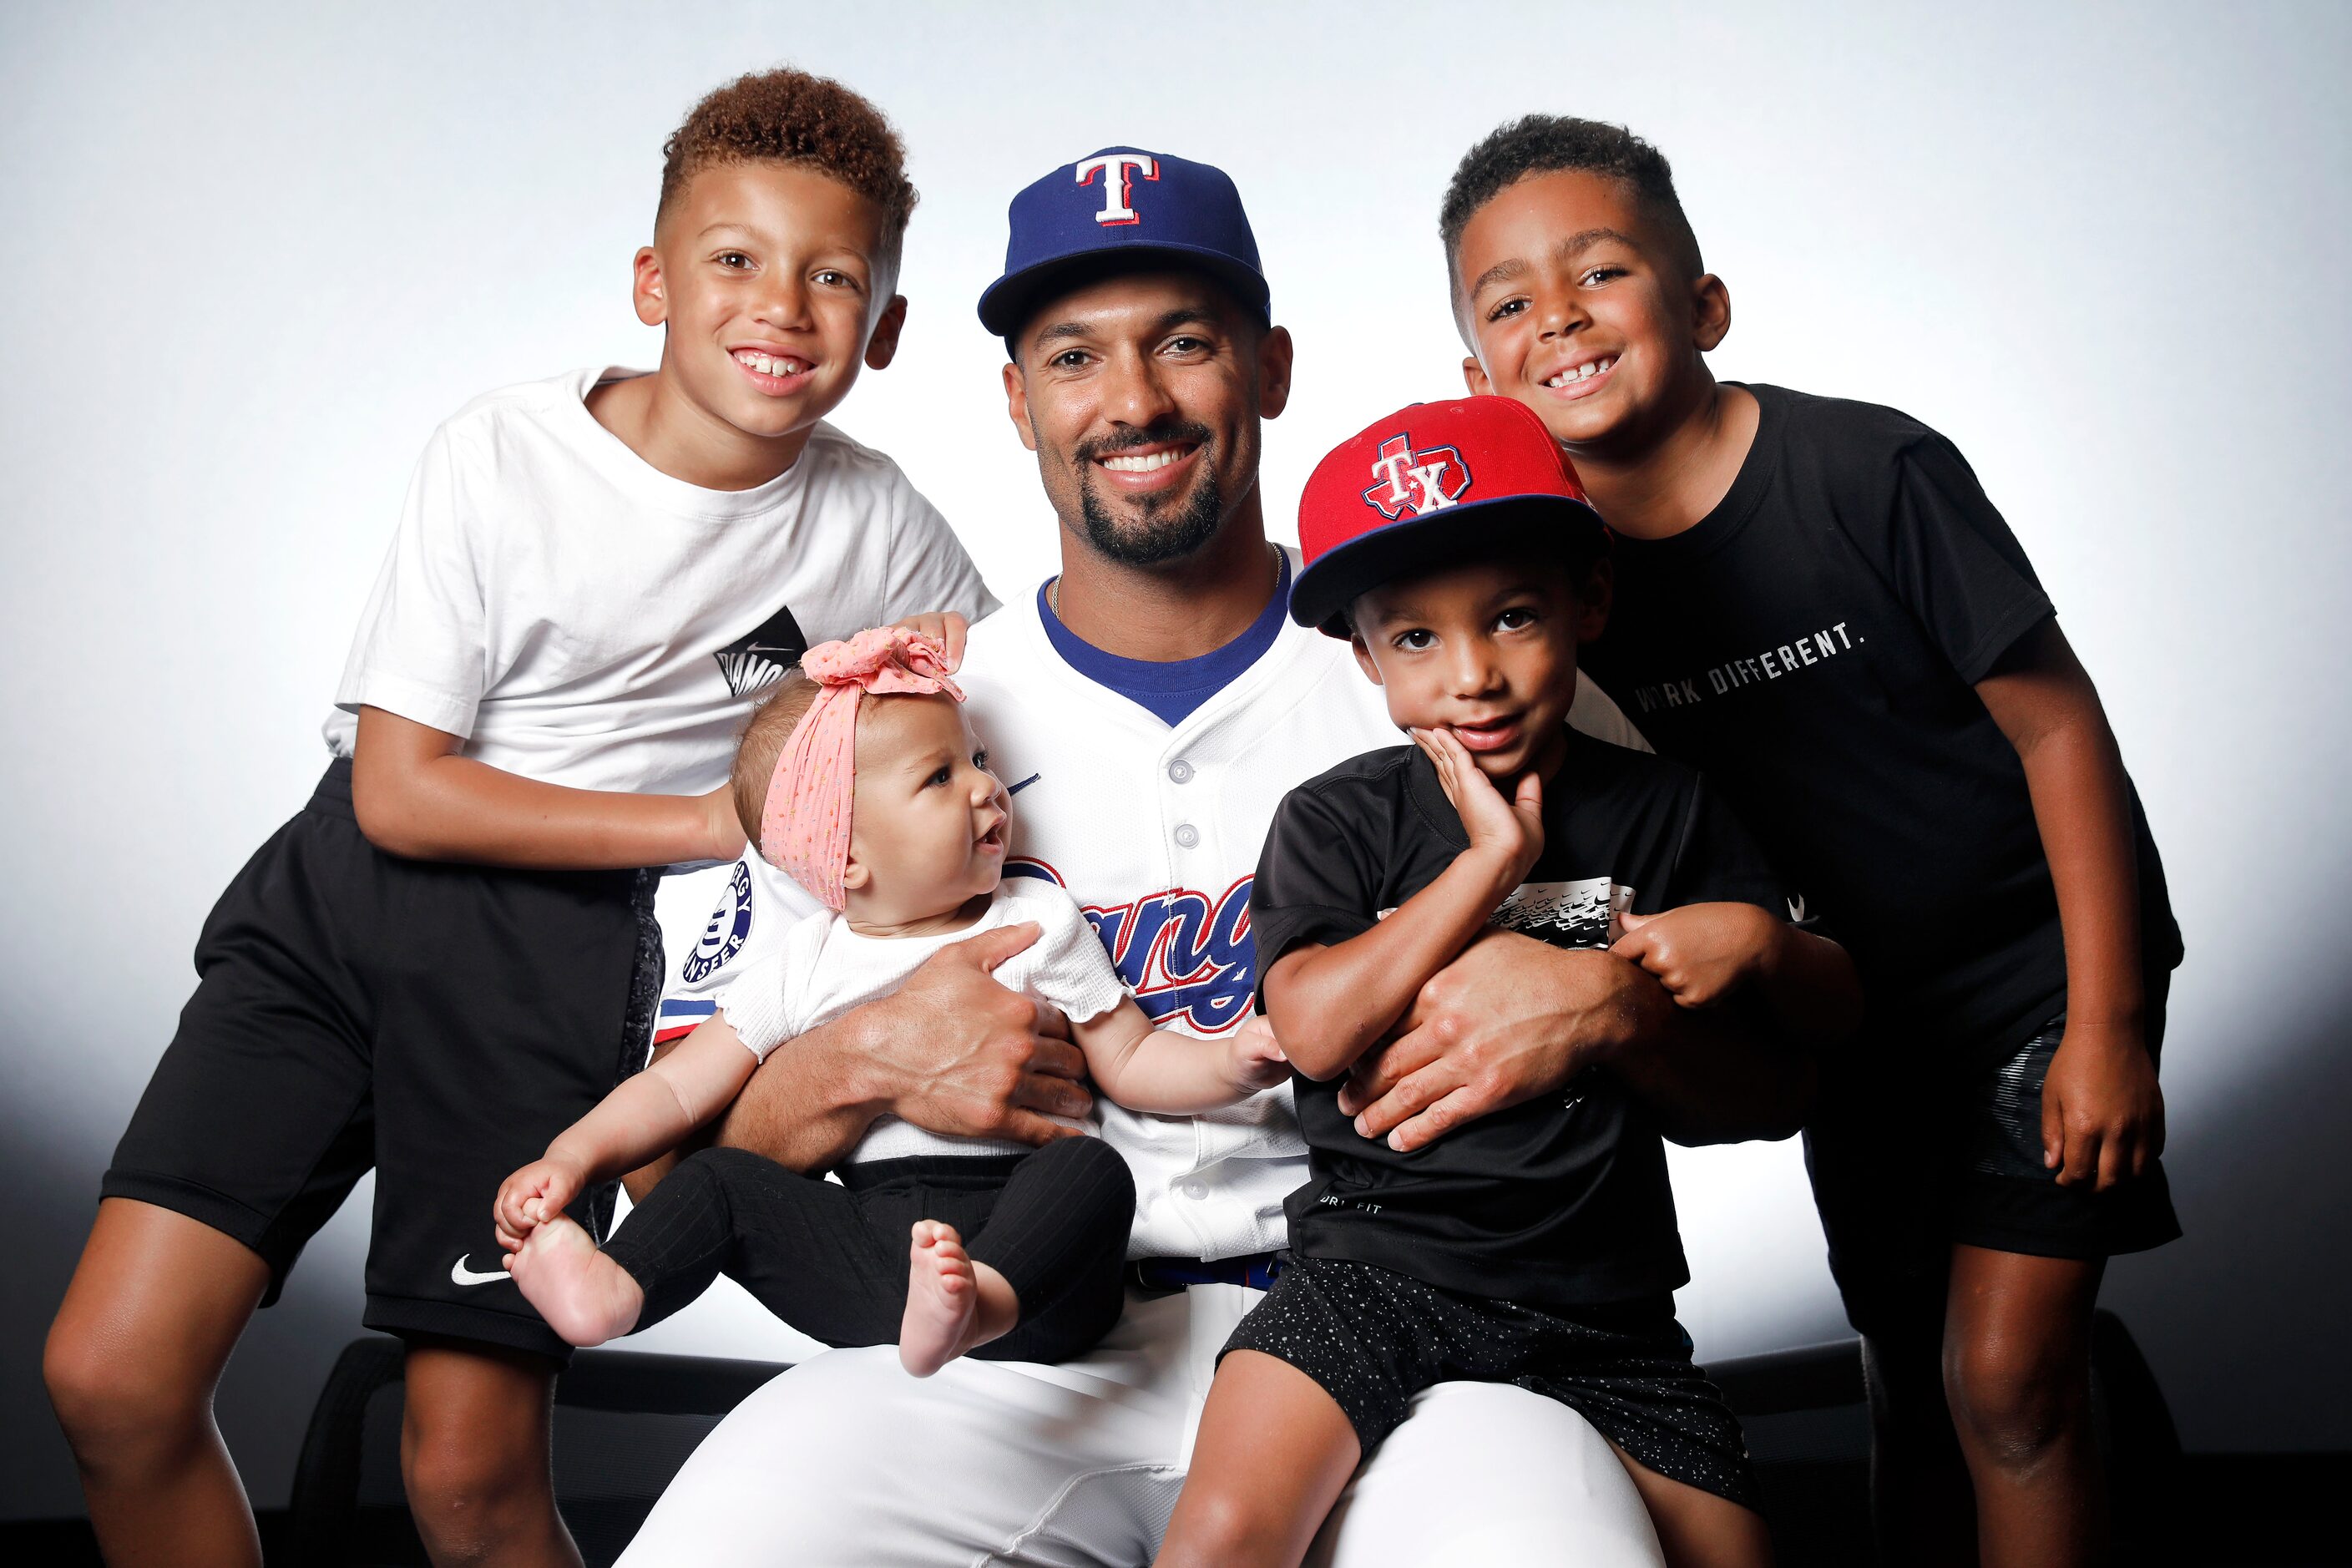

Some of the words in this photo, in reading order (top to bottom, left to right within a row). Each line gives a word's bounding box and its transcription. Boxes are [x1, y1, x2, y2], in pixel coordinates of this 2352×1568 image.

[1075, 154, 1160, 227] T
[1371, 450, 1458, 516] TX
[717, 652, 792, 698] DIAMO
[1708, 622, 1864, 695] DIFFERENT.
